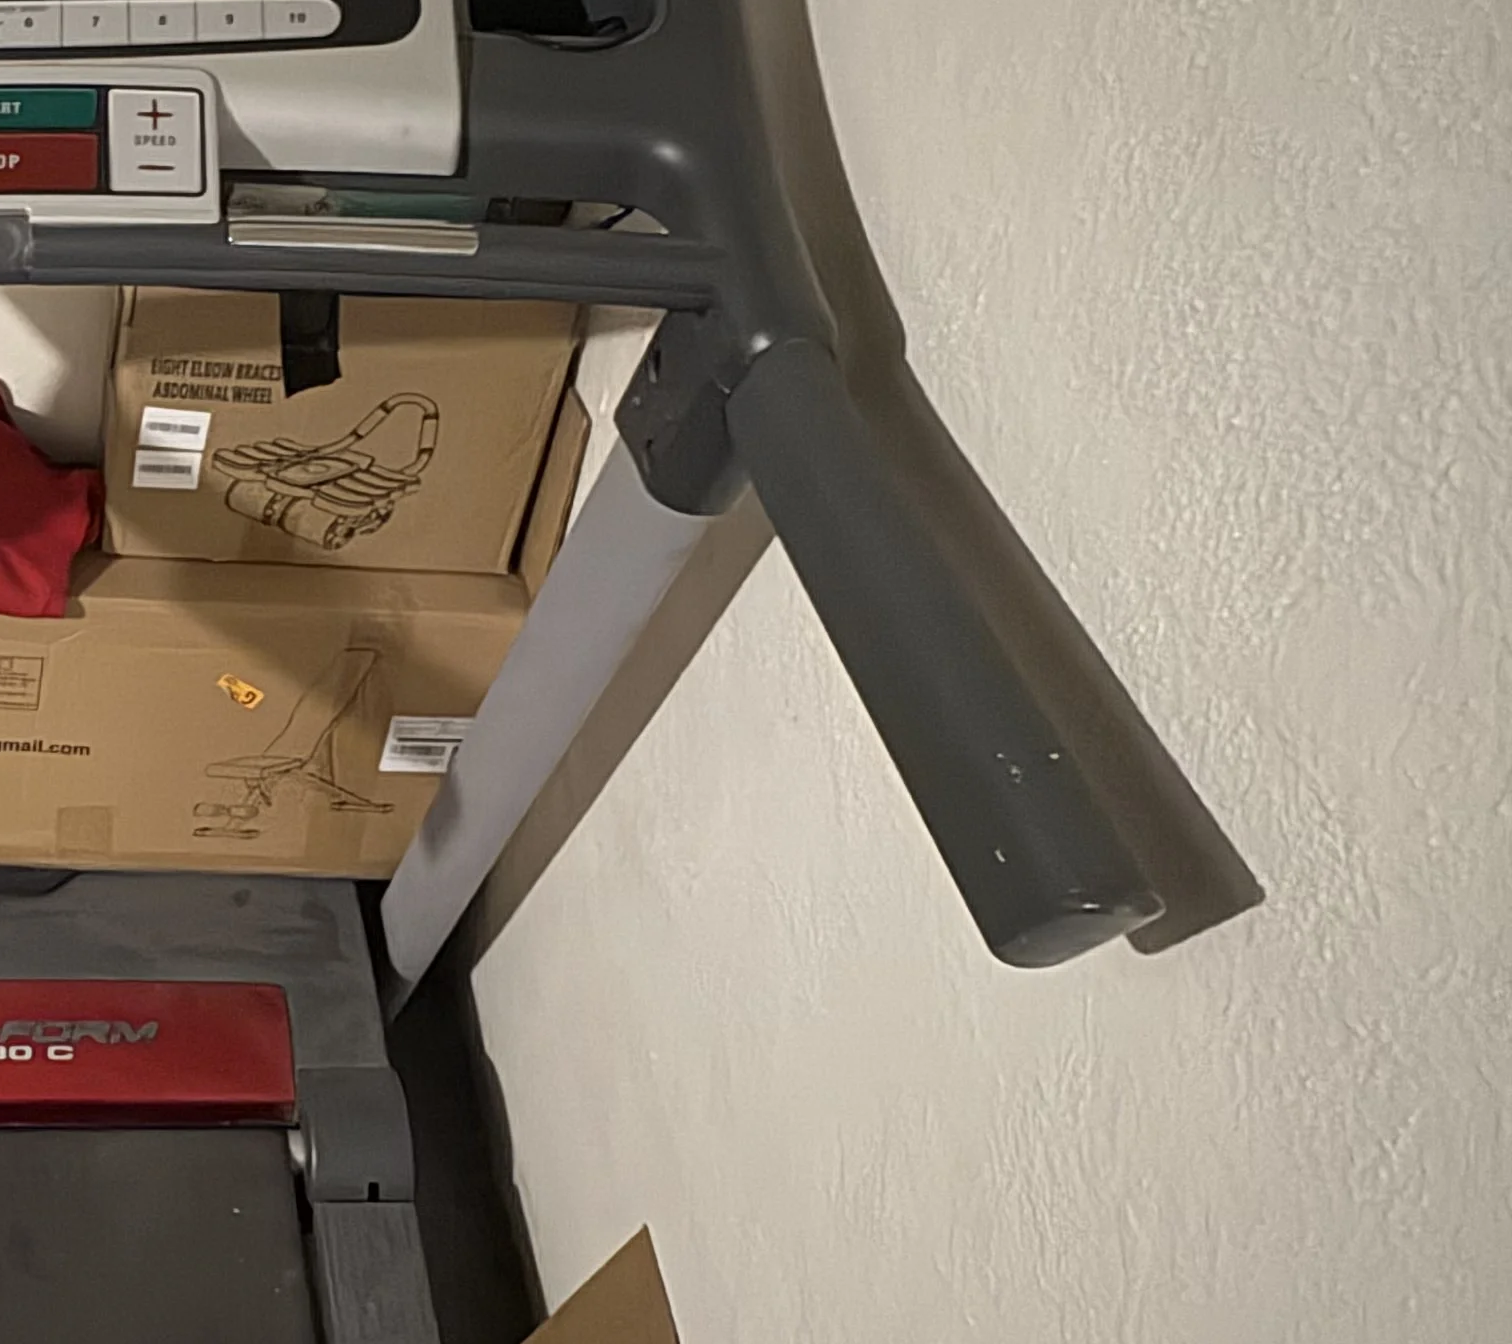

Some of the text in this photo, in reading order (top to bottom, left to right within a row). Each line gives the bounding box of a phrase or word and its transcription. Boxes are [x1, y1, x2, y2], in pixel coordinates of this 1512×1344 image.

[24, 17, 33, 28] 6
[92, 15, 100, 27] 7
[134, 135, 177, 147] SPEED
[231, 385, 272, 405] WHEEL
[47, 1045, 75, 1061] C
